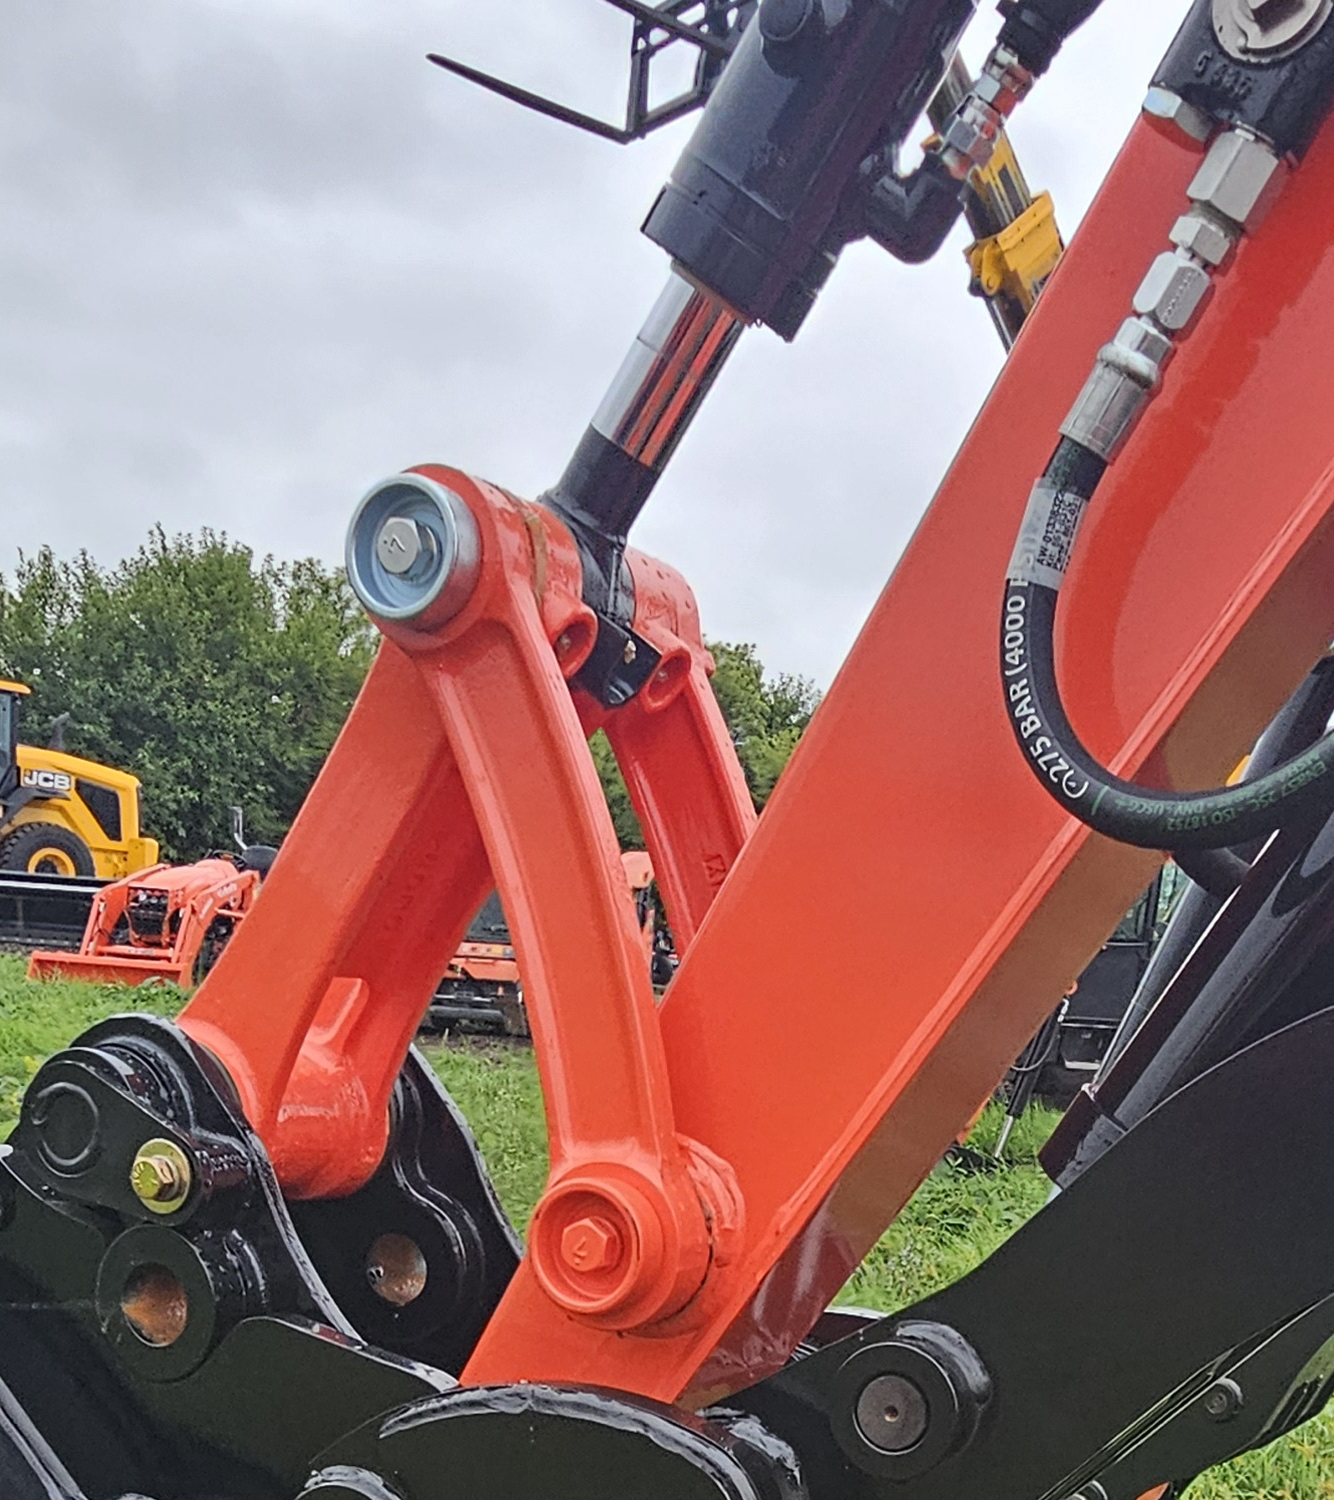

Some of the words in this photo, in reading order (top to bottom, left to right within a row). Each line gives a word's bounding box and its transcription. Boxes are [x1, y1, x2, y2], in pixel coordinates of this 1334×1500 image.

[1004, 595, 1028, 676] (4000
[1009, 678, 1042, 739] BAR
[22, 770, 71, 790] JCB
[1029, 736, 1069, 782] 275
